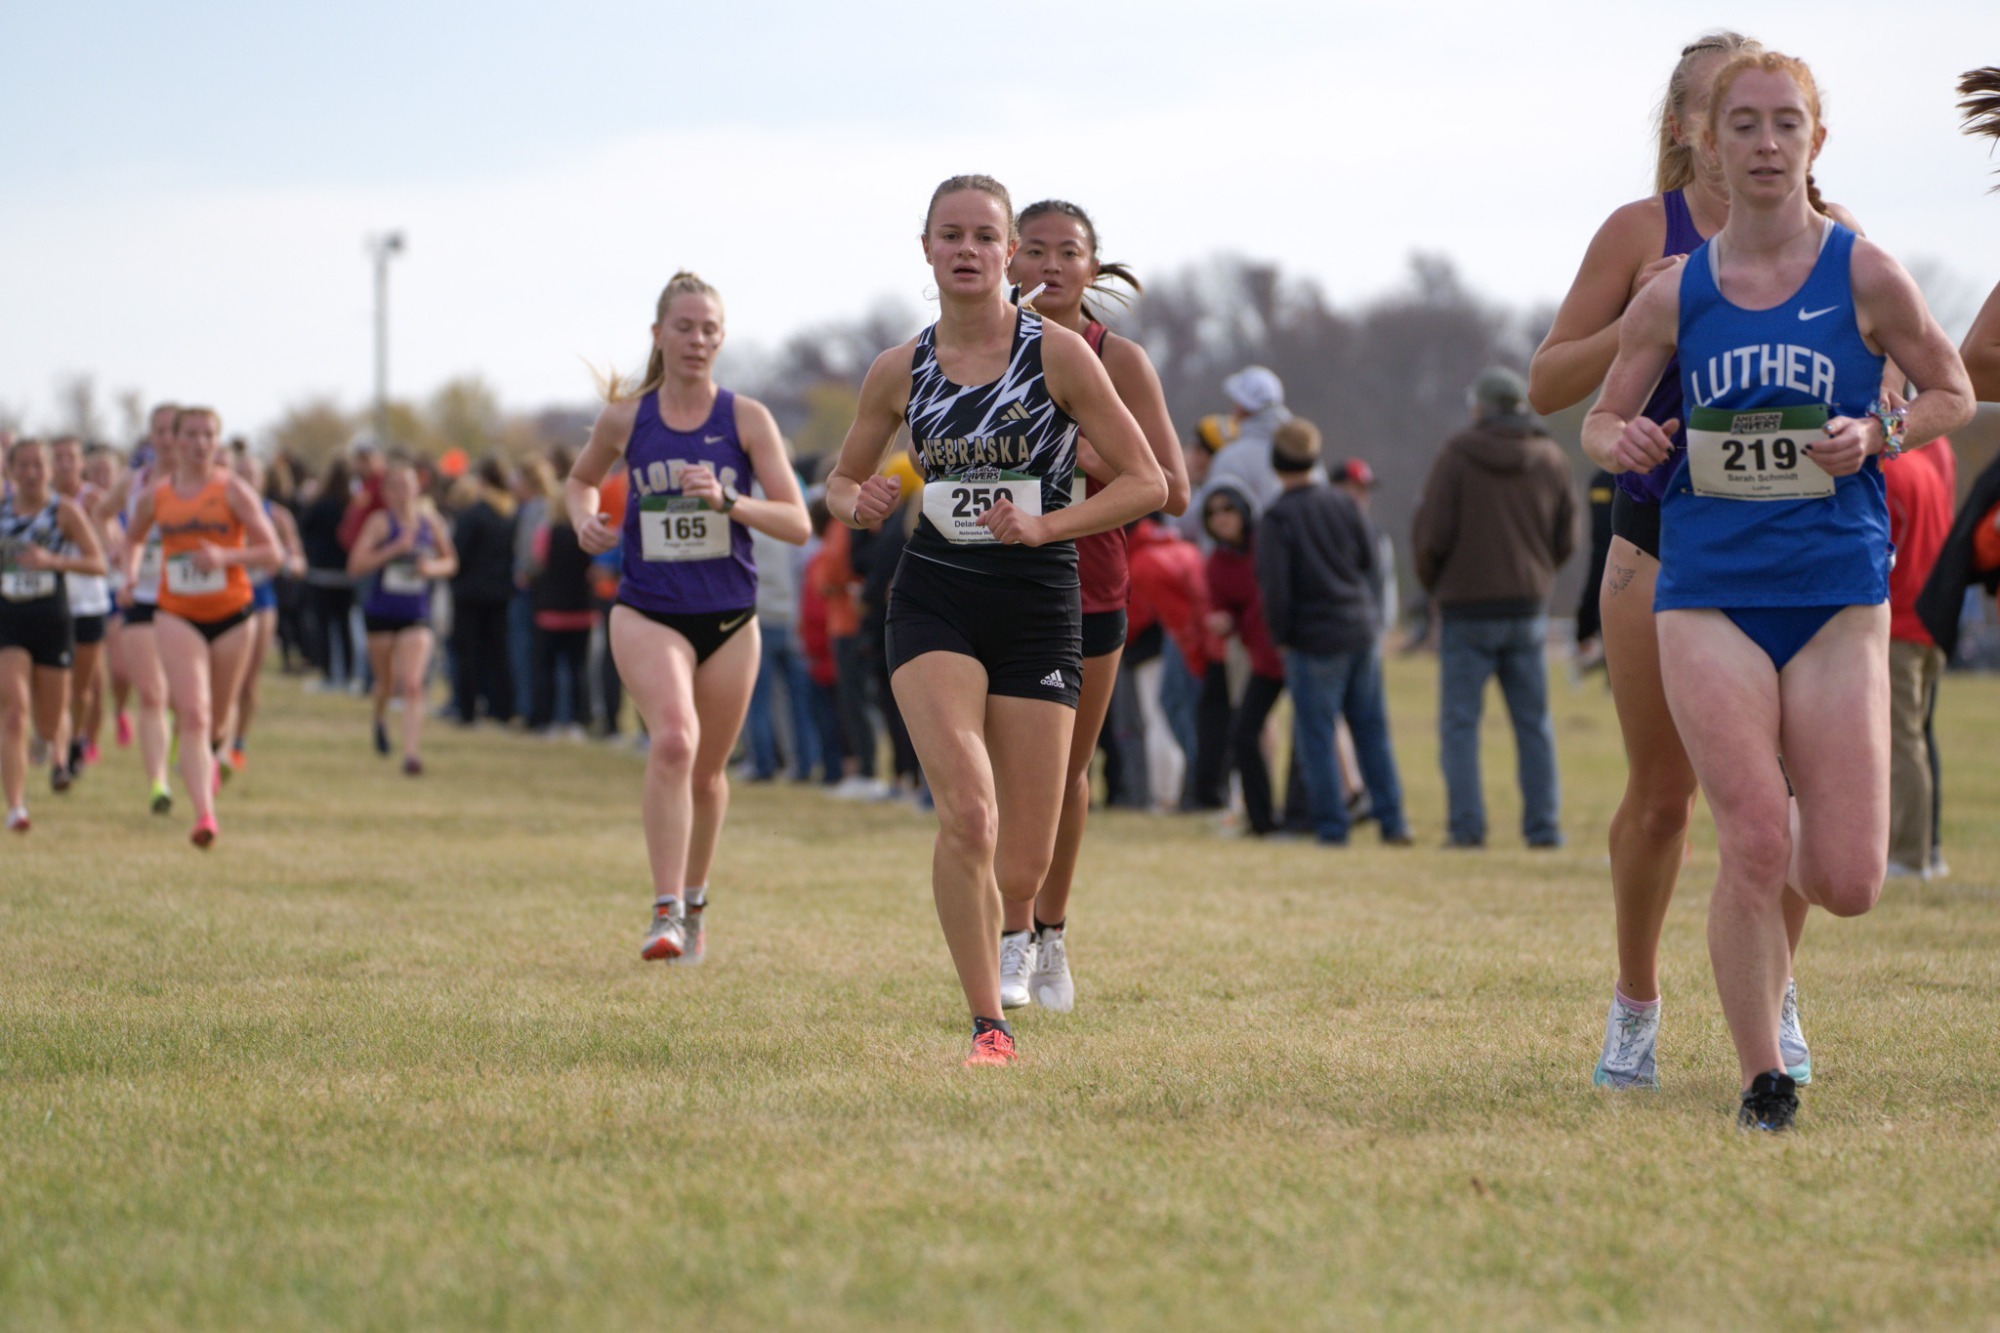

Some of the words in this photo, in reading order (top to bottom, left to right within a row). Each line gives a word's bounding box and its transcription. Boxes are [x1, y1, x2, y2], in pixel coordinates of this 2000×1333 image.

[1691, 343, 1836, 407] LUTHER
[922, 434, 1031, 466] NEBRASKA
[1722, 437, 1797, 471] 219
[1727, 473, 1755, 482] Sarah
[1757, 472, 1798, 482] Schmidt
[660, 517, 707, 540] 165
[1040, 678, 1065, 689] adidas
